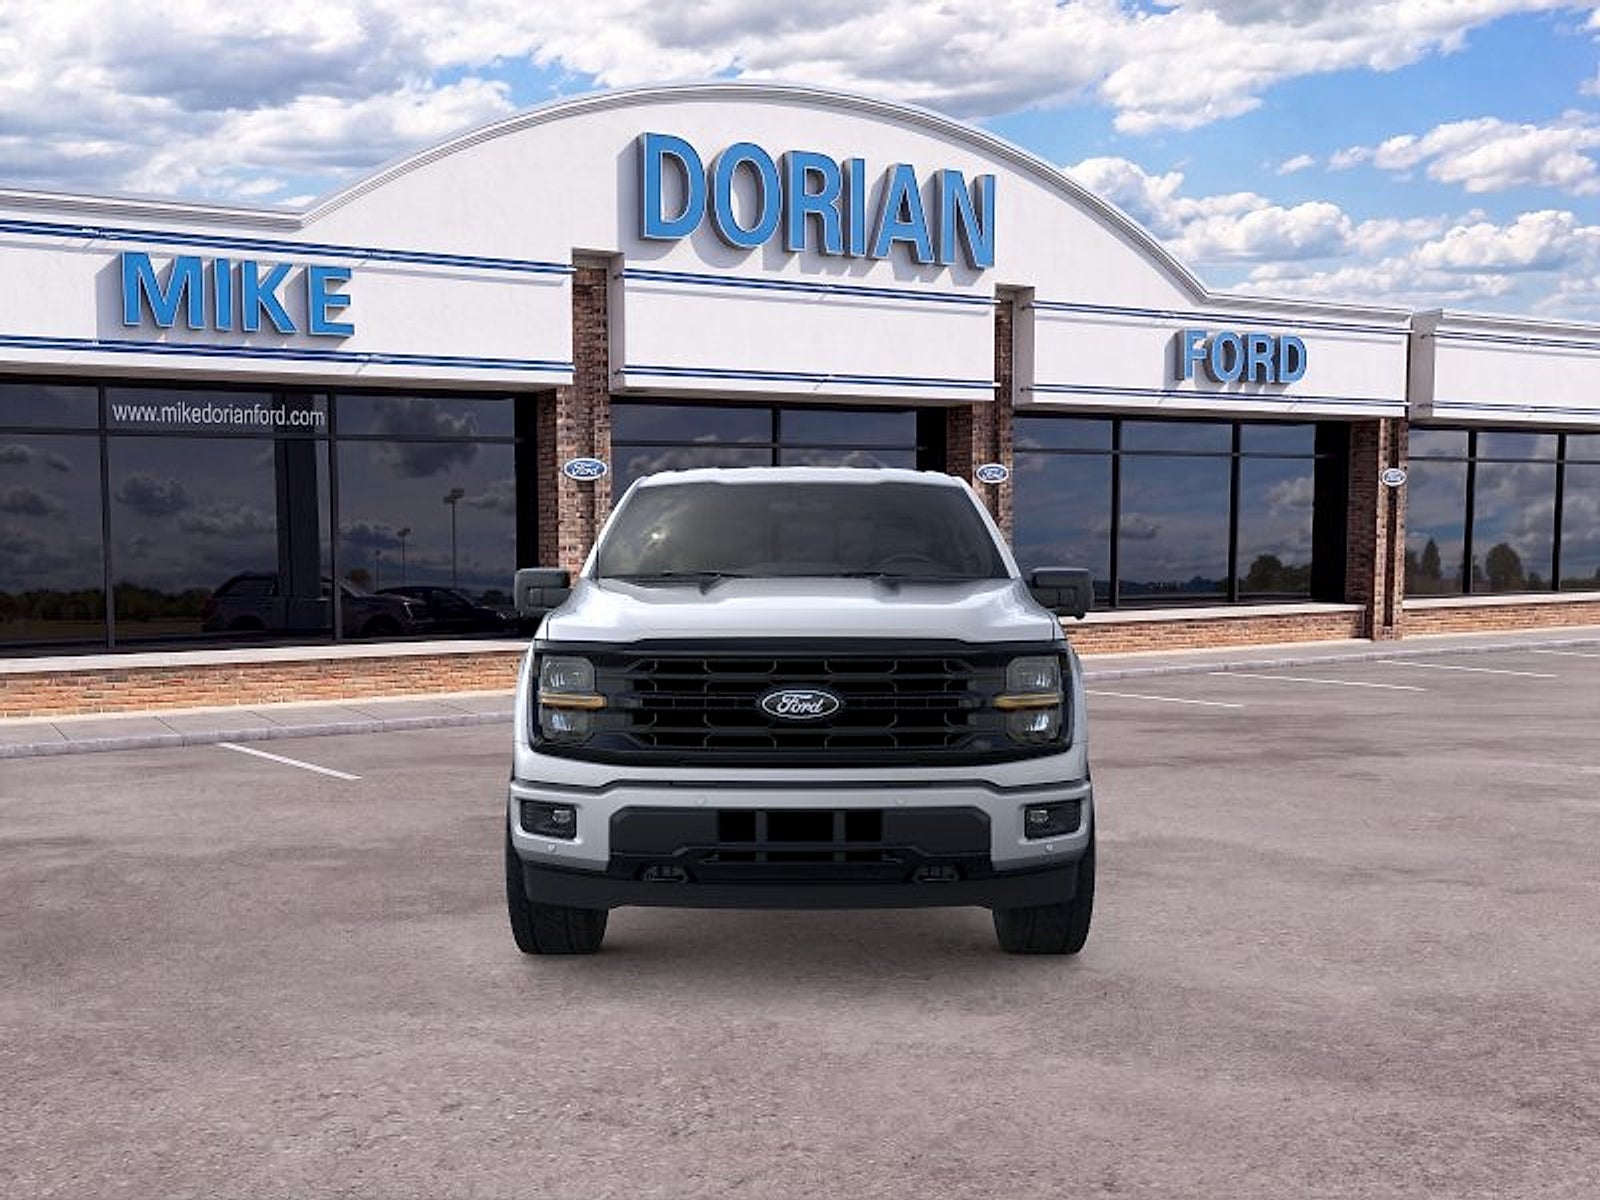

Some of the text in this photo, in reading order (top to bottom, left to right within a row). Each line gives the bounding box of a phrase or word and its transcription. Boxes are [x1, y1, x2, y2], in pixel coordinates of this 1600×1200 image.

[640, 132, 996, 270] DORIAN
[121, 251, 355, 336] MIKE
[1181, 327, 1308, 384] FORD
[112, 402, 326, 426] www.mikedorianford.com
[776, 693, 824, 713] Ford
